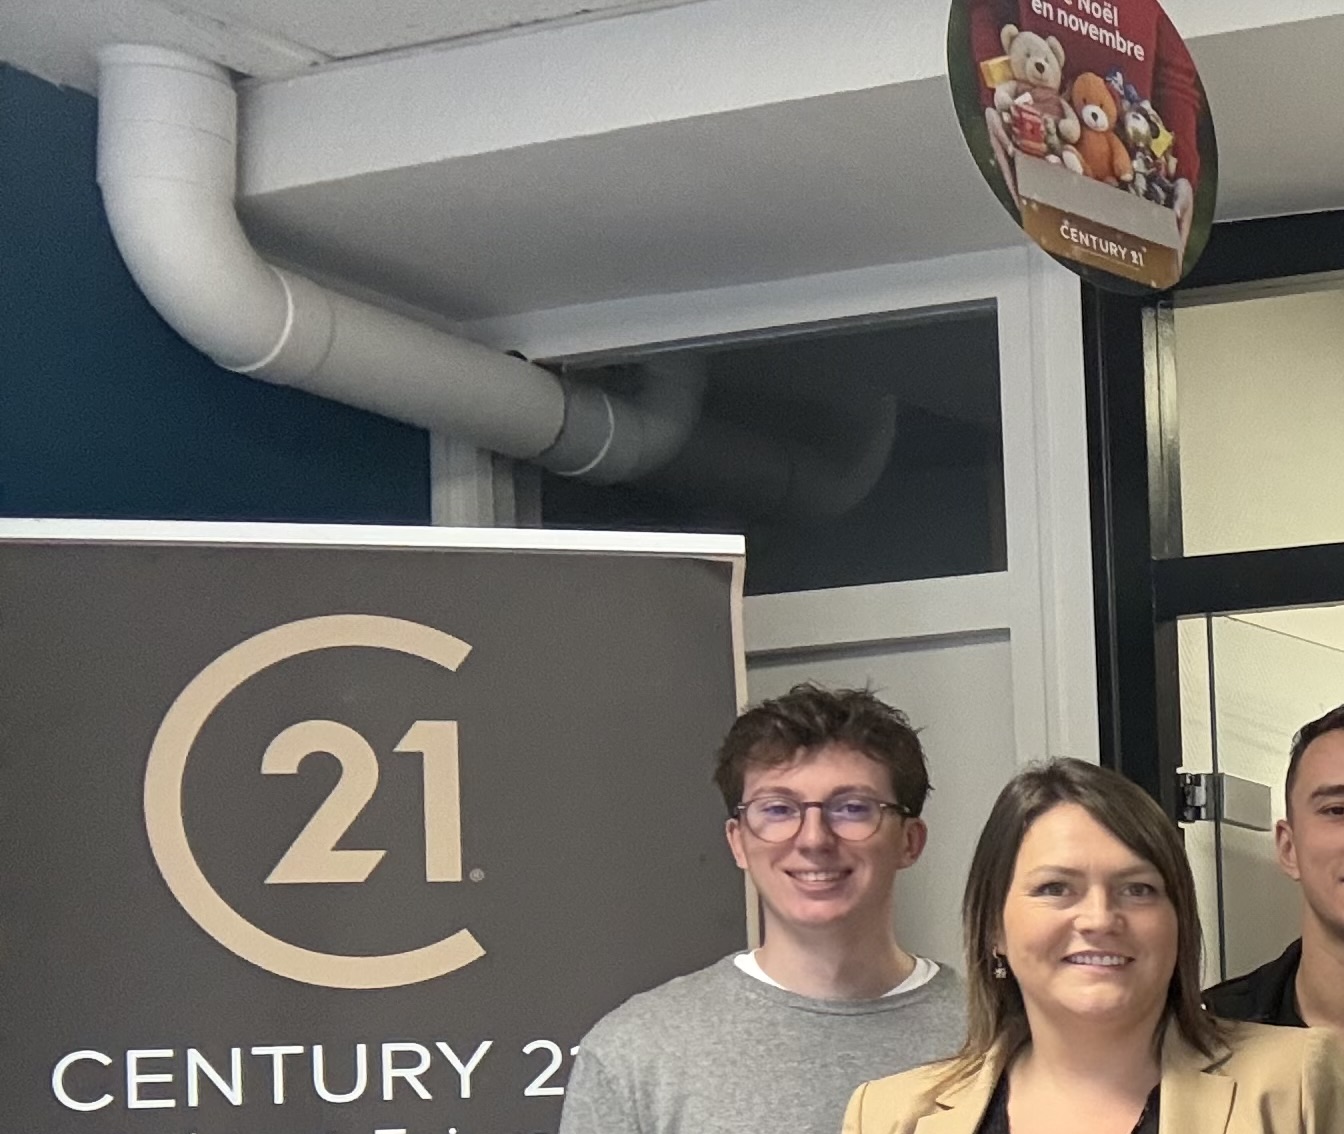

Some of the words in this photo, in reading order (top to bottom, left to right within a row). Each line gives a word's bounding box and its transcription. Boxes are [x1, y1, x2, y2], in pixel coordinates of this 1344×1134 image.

[1031, 0, 1054, 21] en
[1057, 7, 1145, 62] novembre
[1077, 0, 1118, 27] Noël
[1060, 225, 1127, 261] CENTURY
[52, 1039, 494, 1112] CENTURY
[522, 1039, 580, 1096] 2
